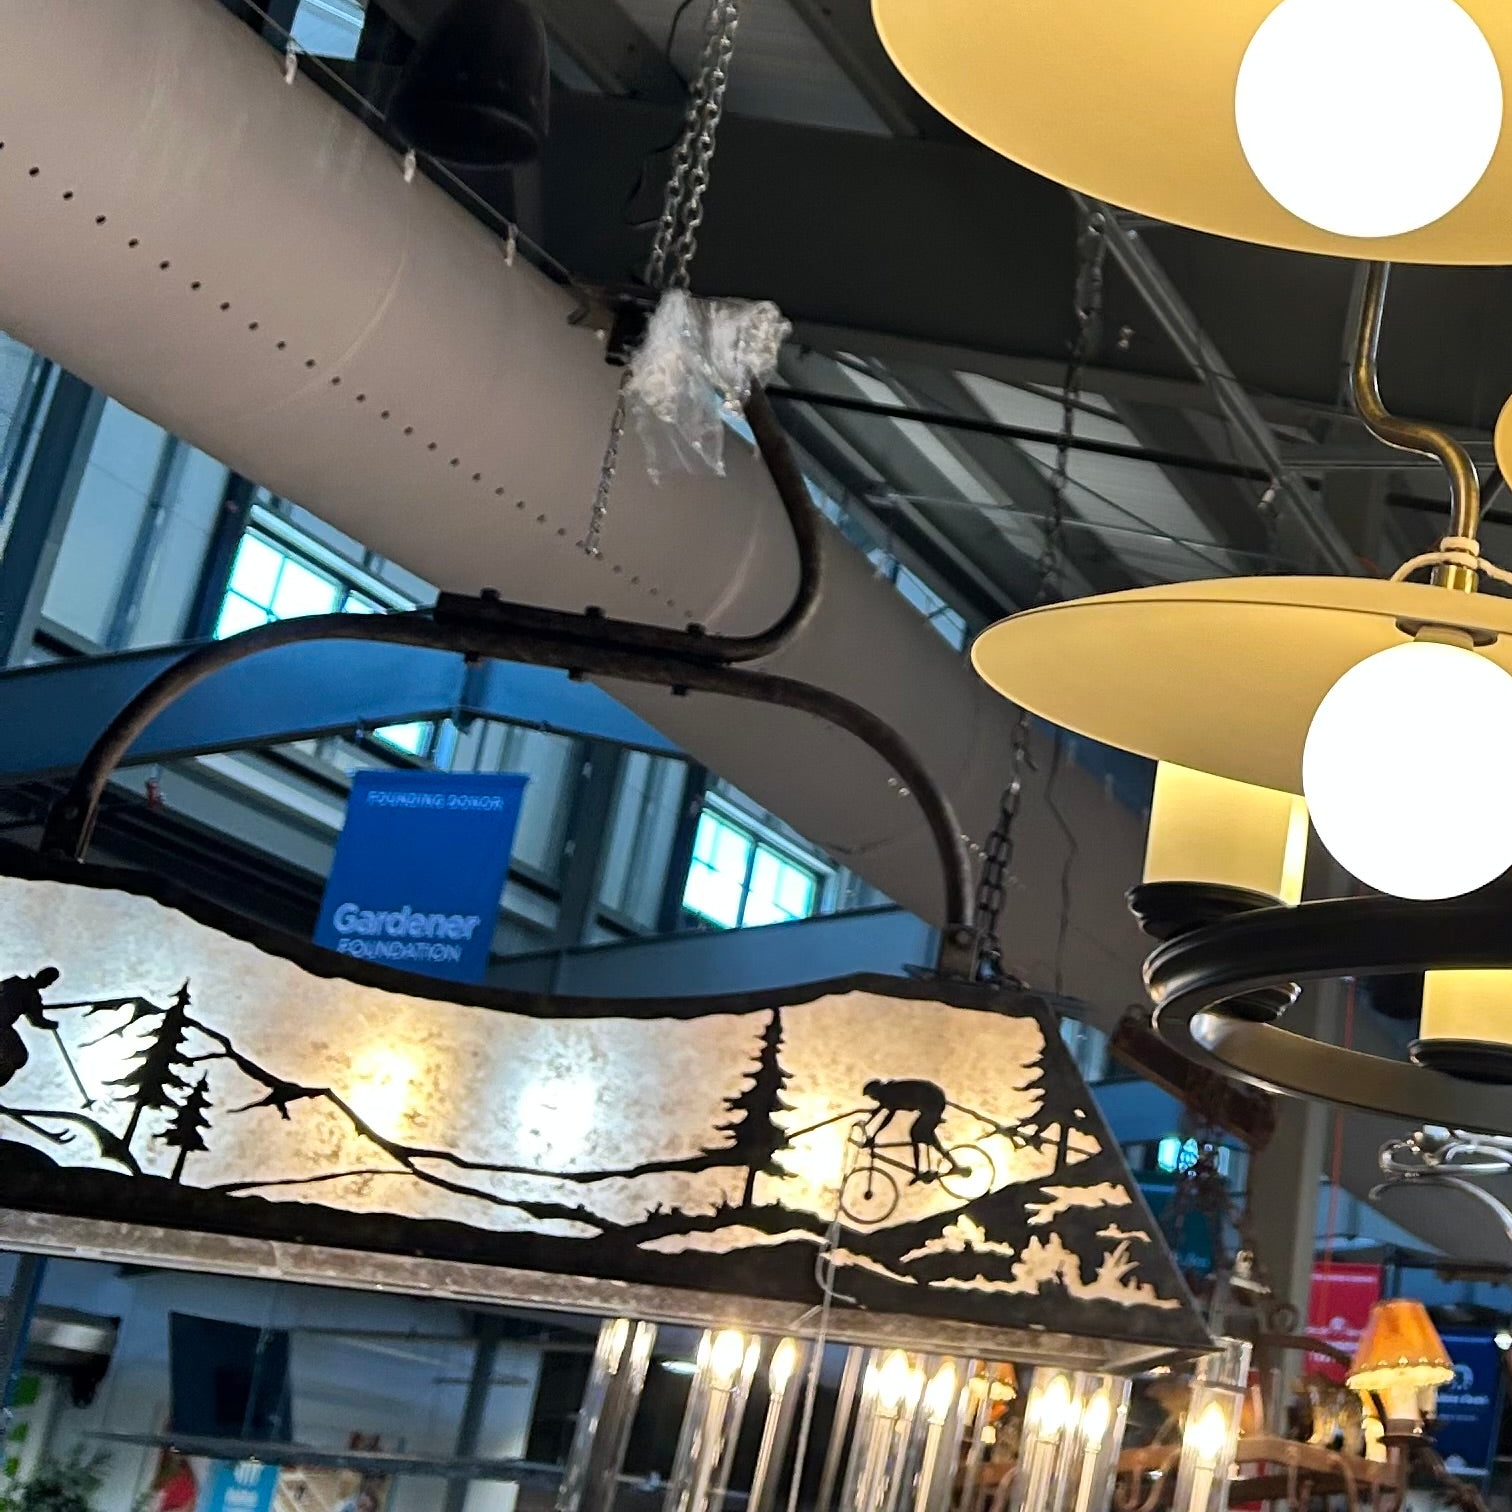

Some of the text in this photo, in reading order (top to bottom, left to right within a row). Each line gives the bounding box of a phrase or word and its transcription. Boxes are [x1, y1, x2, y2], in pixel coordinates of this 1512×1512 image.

[367, 790, 444, 809] FOUNDING
[333, 902, 481, 940] Gardener
[337, 938, 462, 962] FOUNDATION
